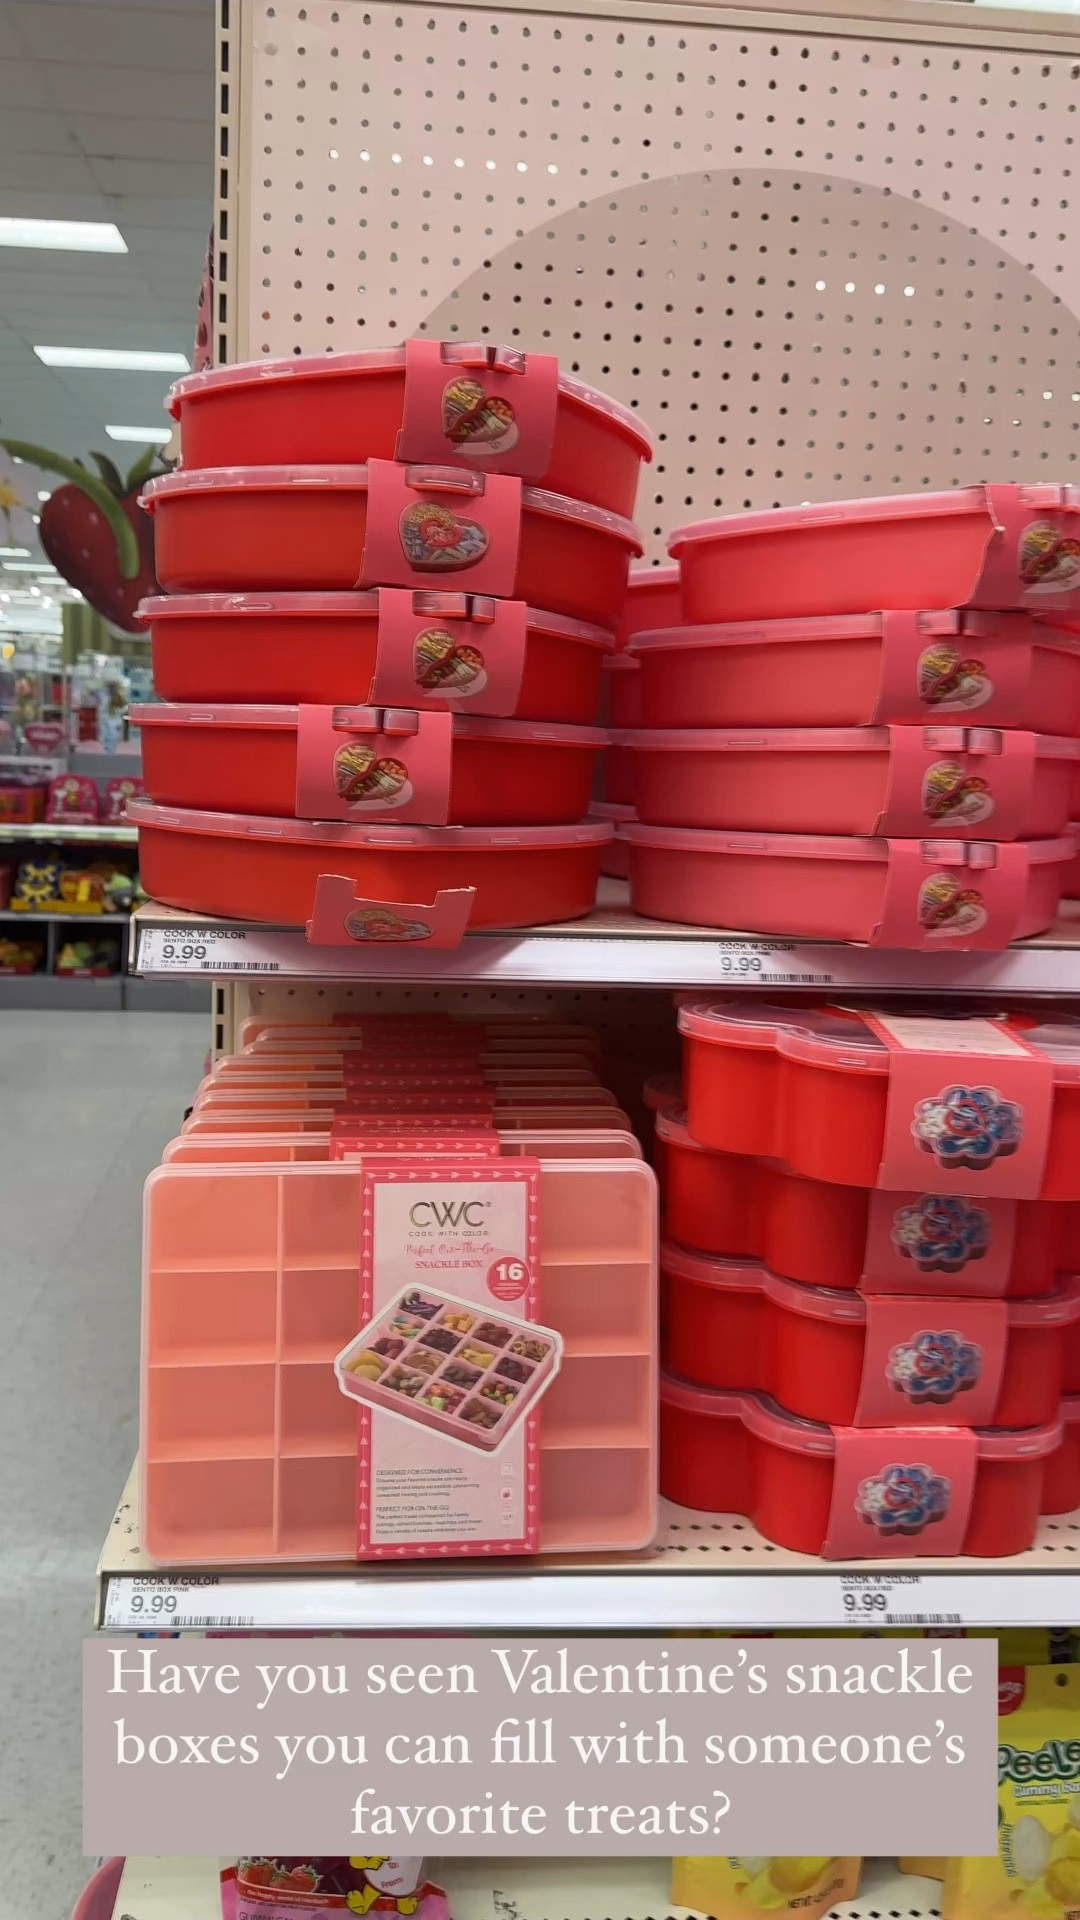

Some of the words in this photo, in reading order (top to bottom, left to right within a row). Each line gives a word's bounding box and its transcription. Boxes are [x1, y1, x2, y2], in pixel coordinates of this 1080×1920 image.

[164, 930, 195, 938] COOK
[198, 930, 206, 938] W
[209, 931, 247, 940] COLOR
[162, 944, 207, 960] 9.99
[721, 956, 761, 972] 9.99
[414, 1260, 460, 1269] SNACKLE
[462, 1260, 483, 1268] BOX
[495, 1262, 524, 1281] 16
[133, 1576, 164, 1585] COOK
[168, 1576, 178, 1585] W
[181, 1576, 219, 1586] COLOR
[131, 1595, 177, 1613] 9.99
[843, 1593, 887, 1611] 9.99
